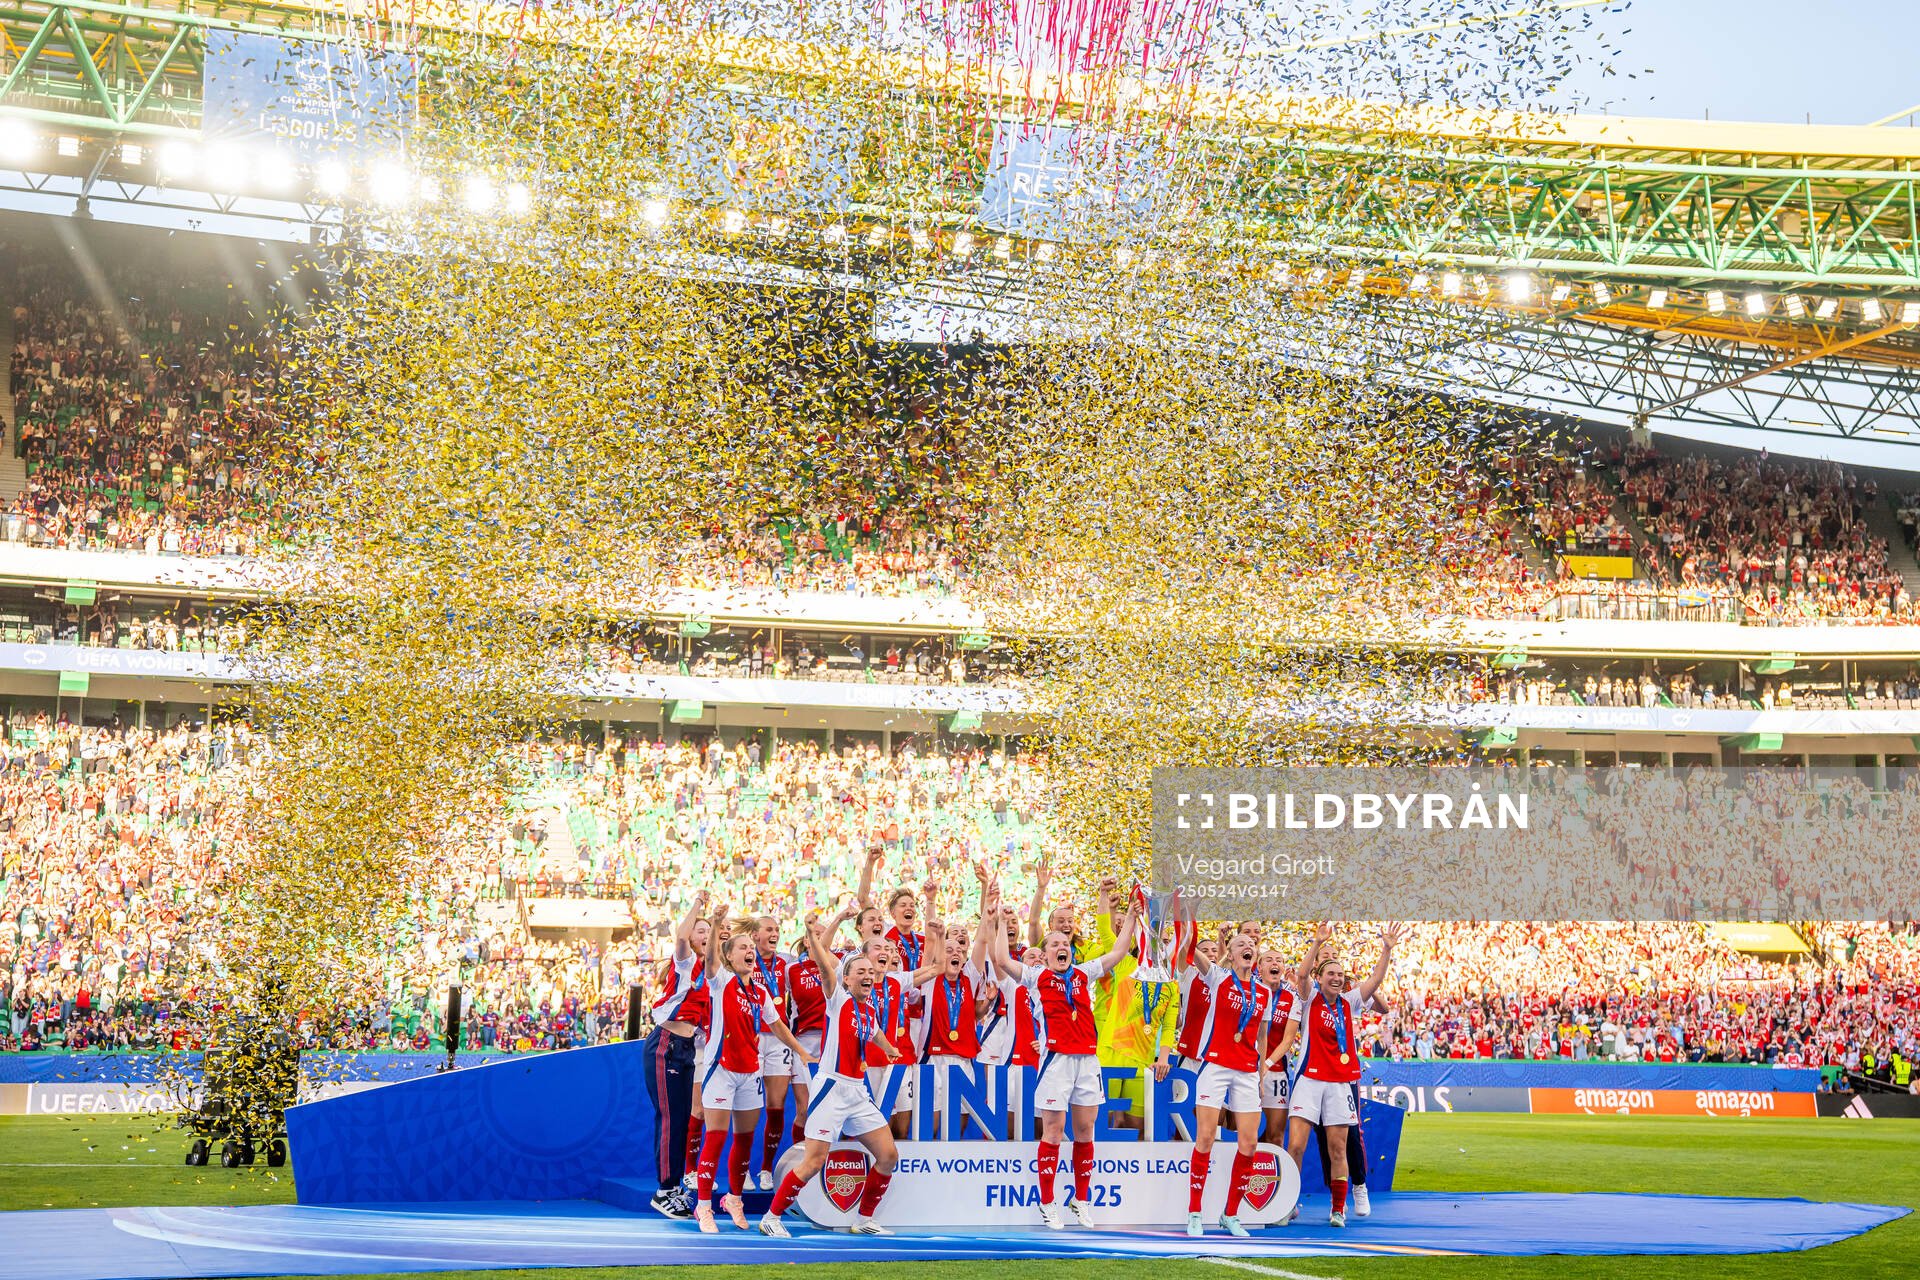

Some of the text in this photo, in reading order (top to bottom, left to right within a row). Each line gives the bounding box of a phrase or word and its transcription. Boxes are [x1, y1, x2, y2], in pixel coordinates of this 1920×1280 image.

[76, 652, 121, 668] UEFA
[1272, 1079, 1288, 1097] 18
[41, 1093, 107, 1113] UEFA
[1347, 1094, 1356, 1113] 8
[1574, 1089, 1654, 1109] amazon
[1696, 1091, 1774, 1110] amazon
[827, 1160, 864, 1170] Arsenal
[936, 1158, 1022, 1173] WOMEN'S
[1252, 1160, 1275, 1170] senal
[986, 1185, 1041, 1207] FINA
